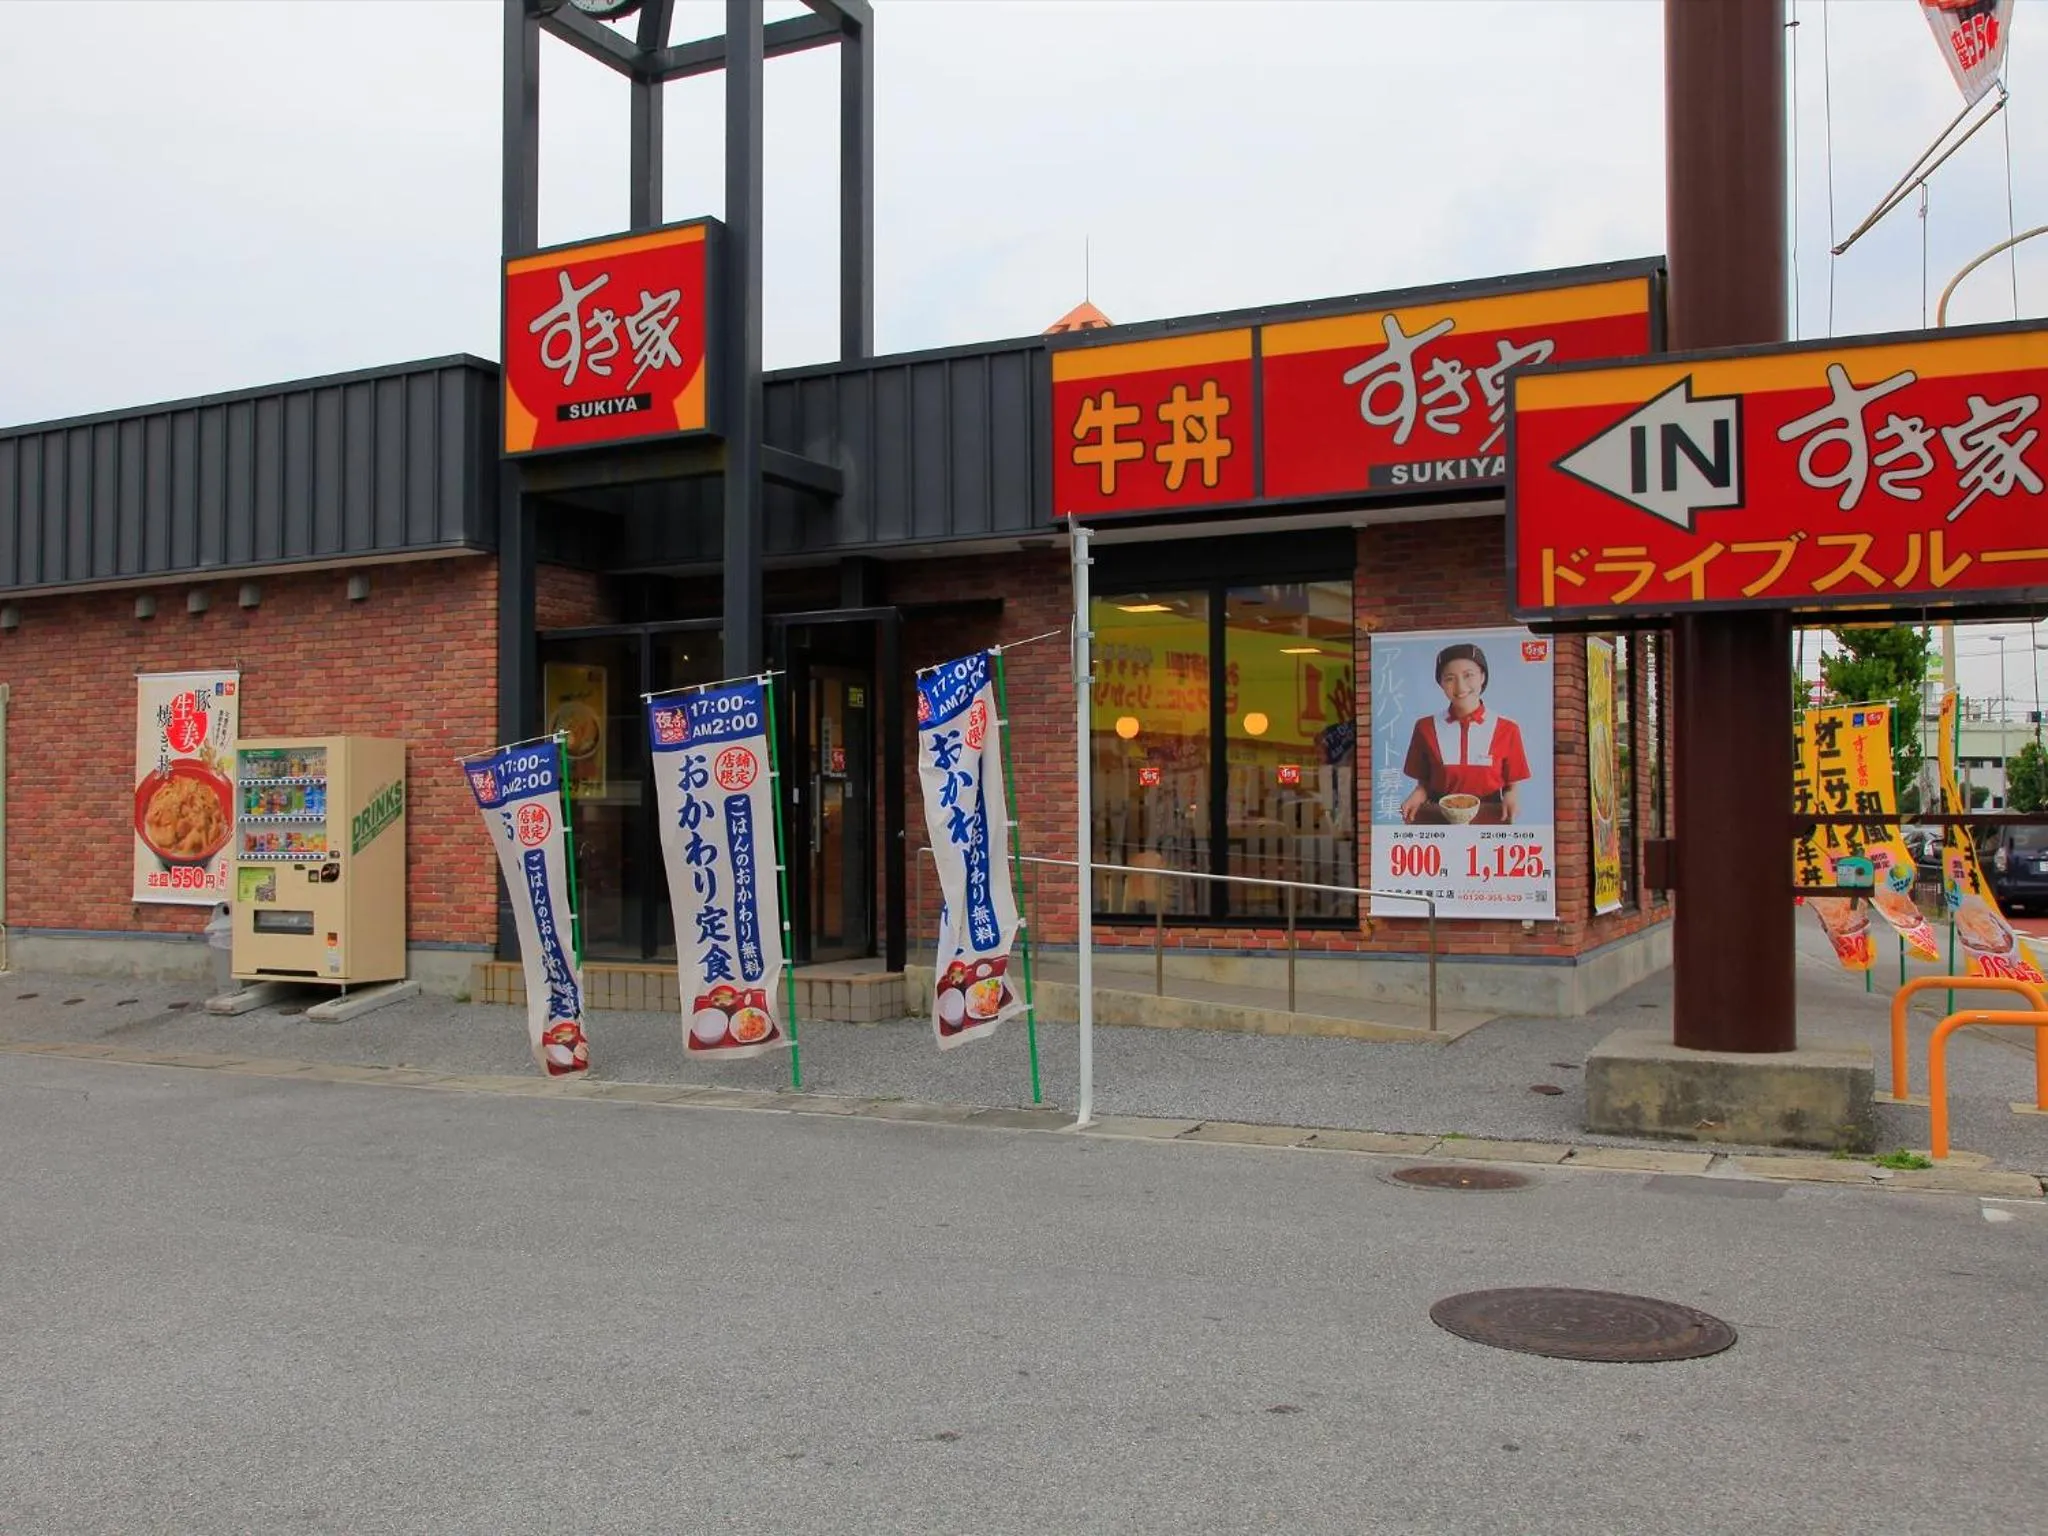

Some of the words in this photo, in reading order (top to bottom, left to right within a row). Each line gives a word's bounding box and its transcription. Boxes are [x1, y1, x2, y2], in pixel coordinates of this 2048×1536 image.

[528, 270, 683, 391] すき家
[568, 396, 639, 420] SUKIYA
[1072, 379, 1233, 496] 牛丼
[1629, 417, 1731, 494] IN
[1776, 361, 2044, 521] すき家
[1390, 456, 1506, 486] SUKIYA
[1540, 526, 2048, 608] ドライブスルー
[692, 711, 759, 739] AM2:00
[1376, 648, 1403, 821] アルバイト募集
[352, 779, 404, 842] DRINKS
[677, 754, 737, 984] おかわり定食
[729, 798, 763, 976] ごはんのおかわり無料
